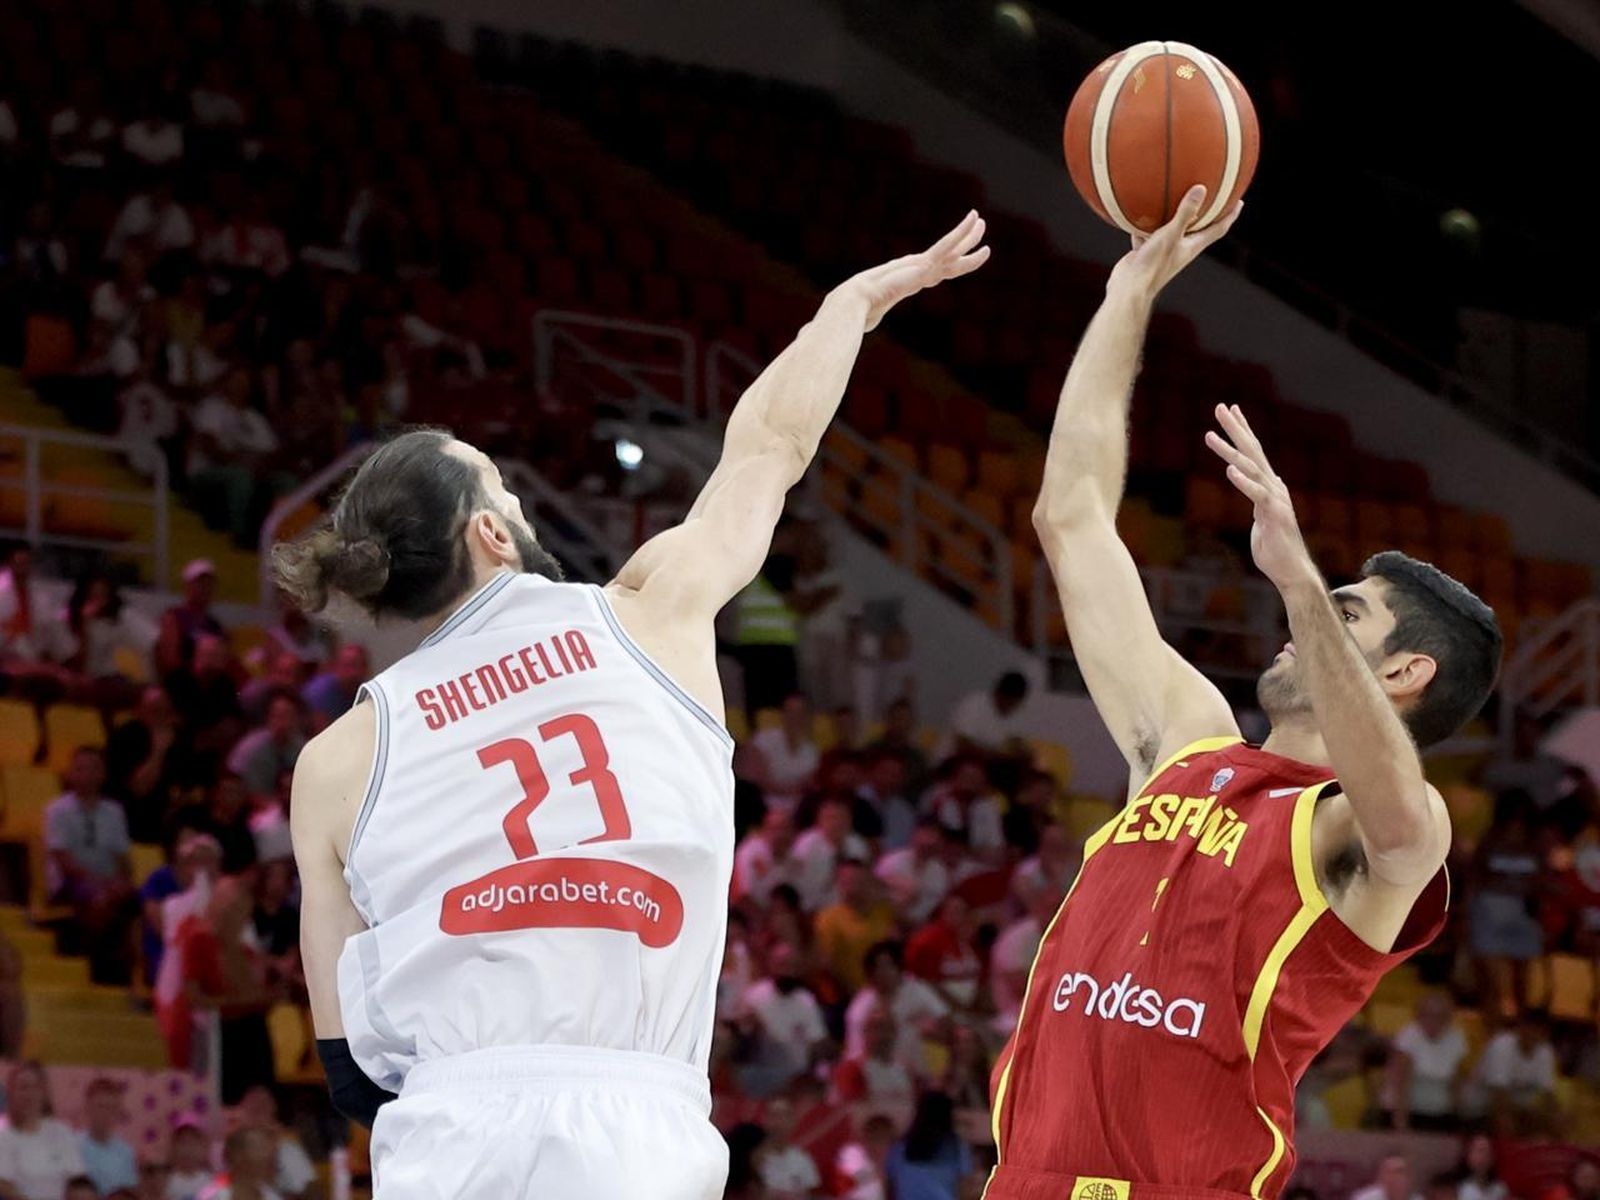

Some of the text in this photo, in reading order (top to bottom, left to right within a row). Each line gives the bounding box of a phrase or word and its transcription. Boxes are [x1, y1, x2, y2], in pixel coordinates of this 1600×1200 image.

[415, 630, 597, 731] SHENGELIA
[476, 713, 632, 861] 23
[461, 877, 660, 922] adjarabet.com
[1053, 972, 1206, 1038] endesa
